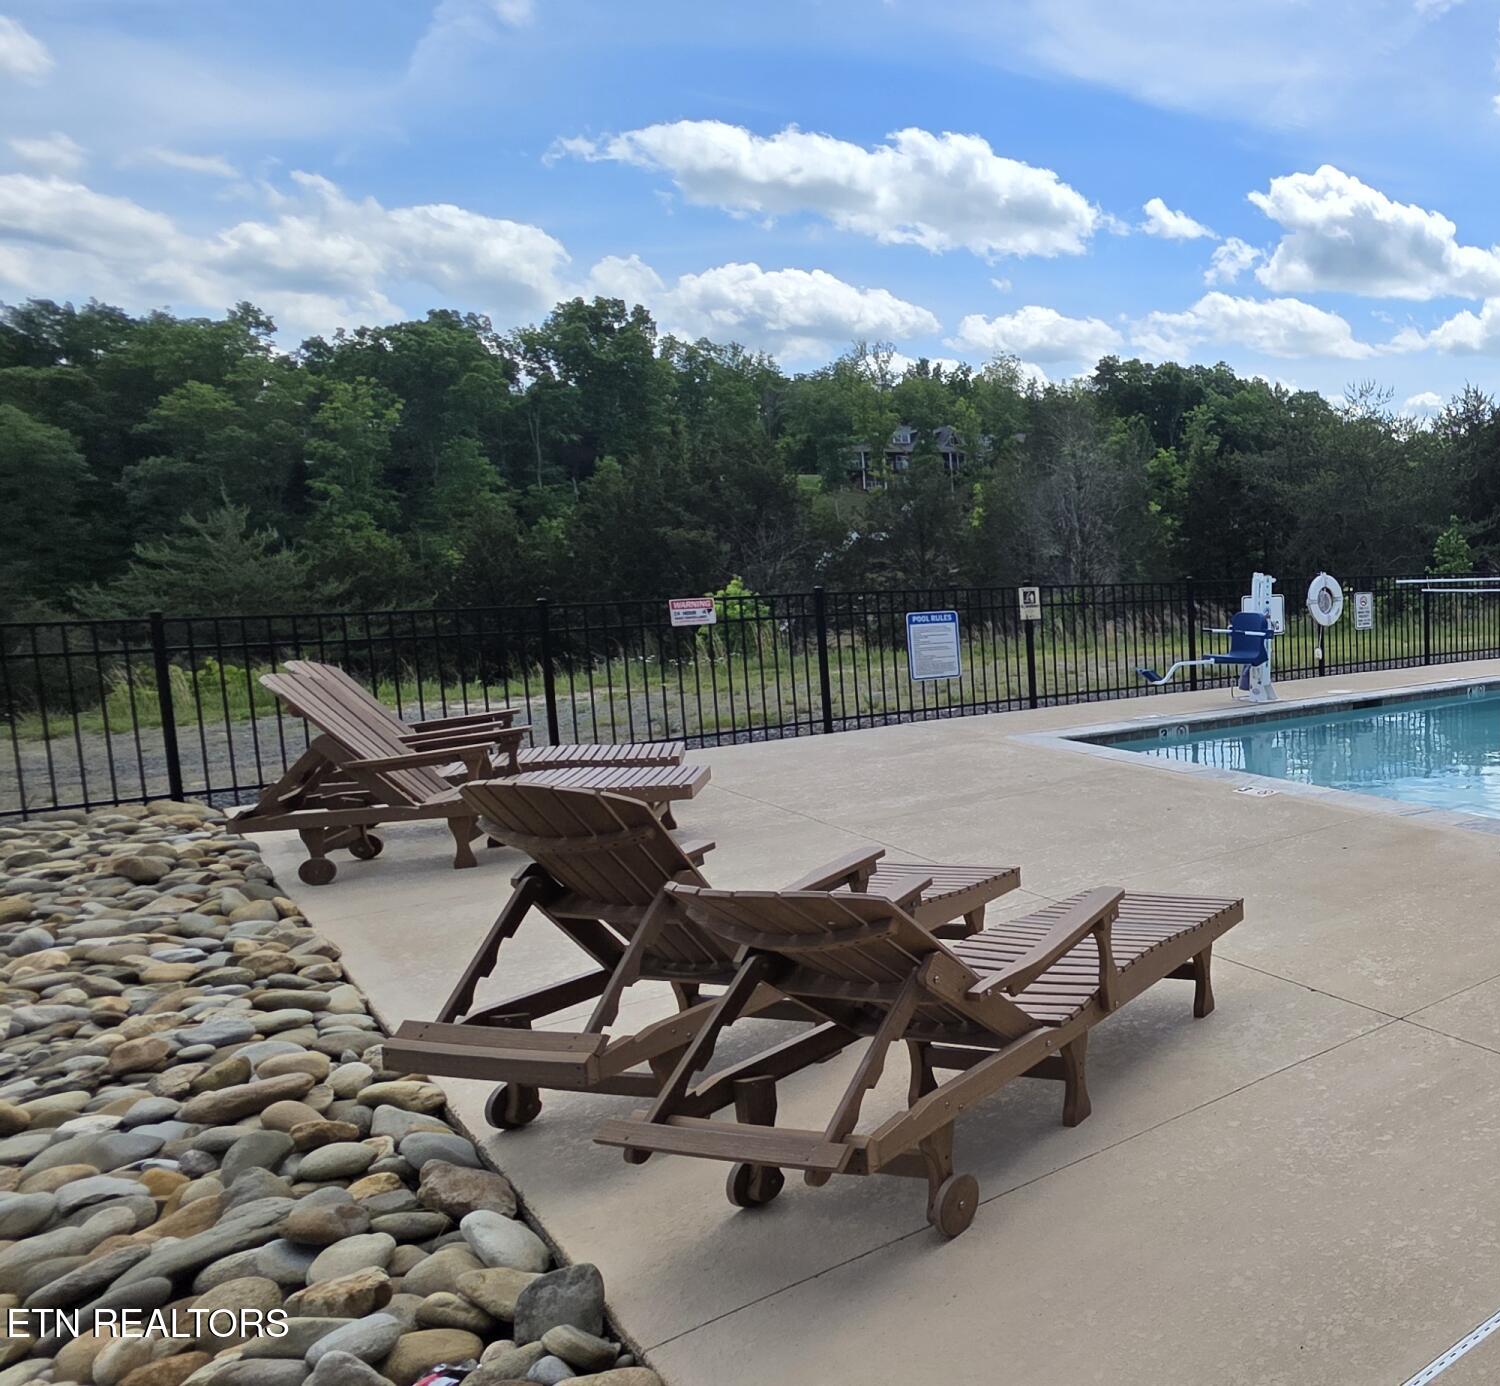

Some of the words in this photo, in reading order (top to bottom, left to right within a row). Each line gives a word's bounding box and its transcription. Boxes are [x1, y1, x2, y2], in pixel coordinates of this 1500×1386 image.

[672, 600, 711, 609] WARNING
[912, 615, 930, 623] POOL
[931, 614, 952, 622] RULES
